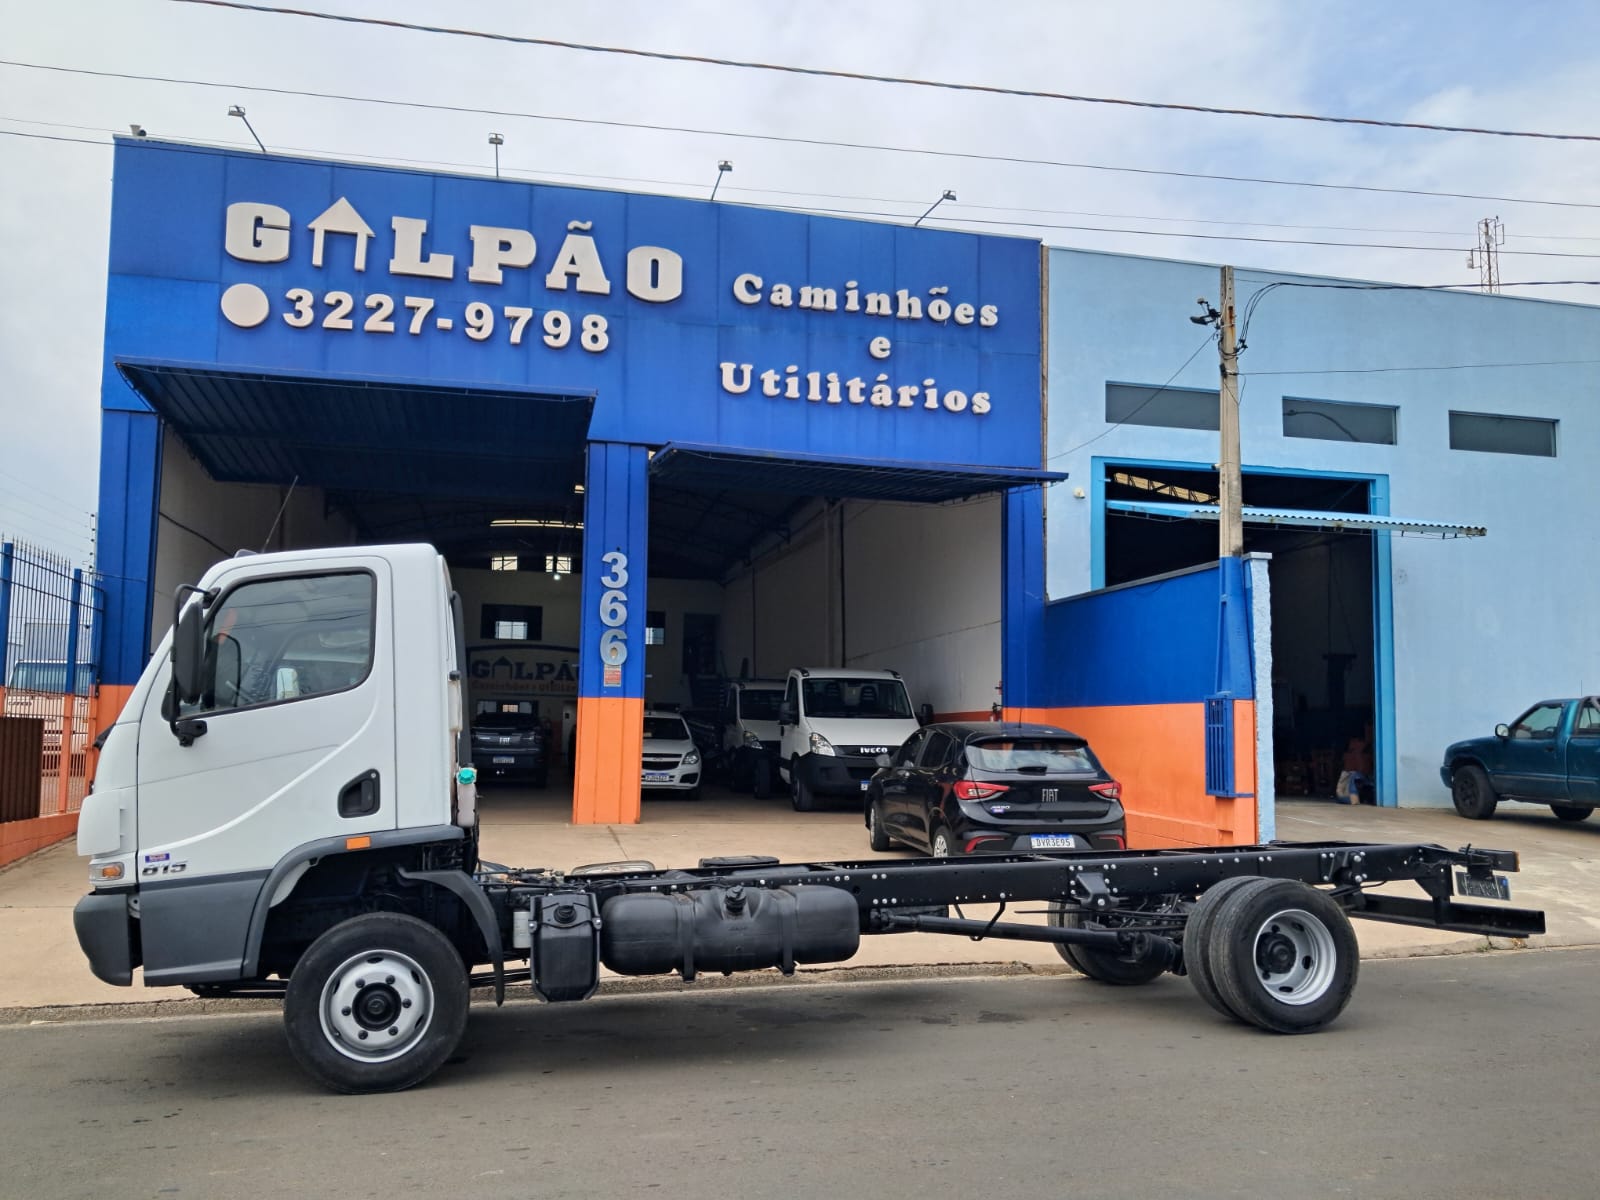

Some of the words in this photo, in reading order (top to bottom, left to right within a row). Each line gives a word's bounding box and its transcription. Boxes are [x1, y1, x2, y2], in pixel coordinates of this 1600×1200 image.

[283, 287, 610, 352] 3227-9798
[733, 273, 999, 327] Caminhões
[869, 336, 892, 359] e
[720, 362, 992, 415] Utilitários
[600, 551, 629, 665] 366
[1041, 788, 1059, 803] FIAT
